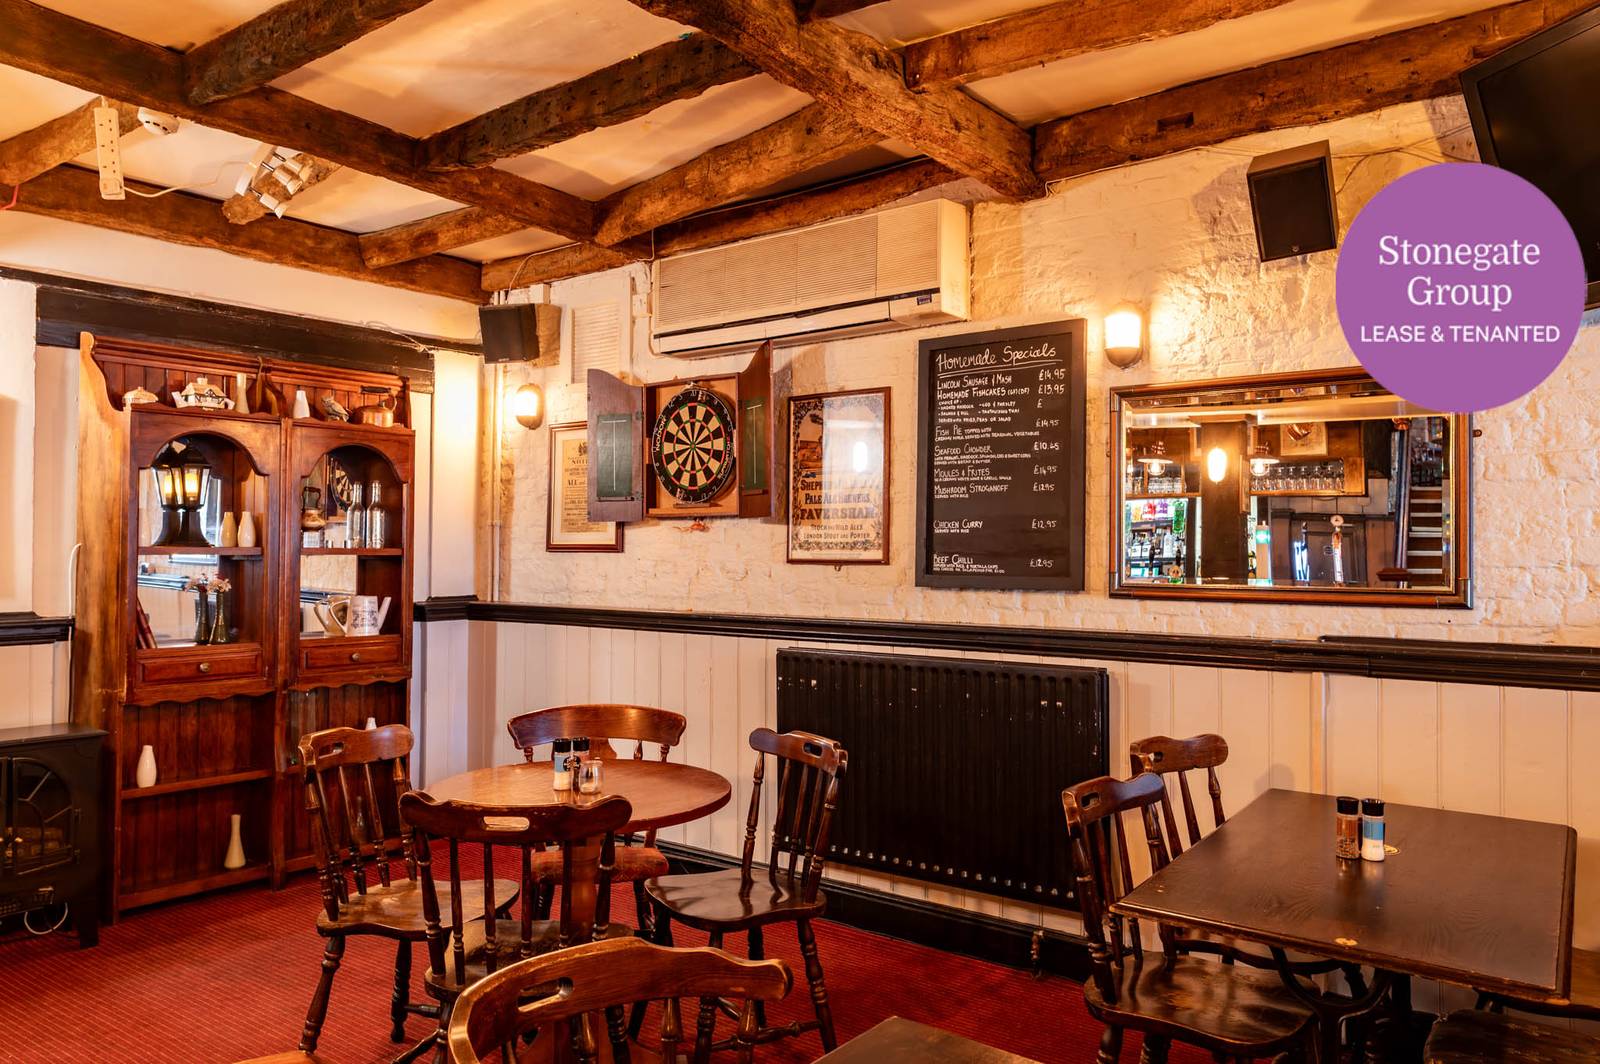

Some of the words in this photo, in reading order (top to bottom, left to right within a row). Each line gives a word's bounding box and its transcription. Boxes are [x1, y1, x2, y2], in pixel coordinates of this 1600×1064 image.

[935, 348, 997, 371] Homemade
[1002, 343, 1056, 366] Specials
[937, 380, 960, 390] LINCOLN
[996, 374, 1012, 385] MASH
[1039, 369, 1066, 381] £14.95
[937, 391, 969, 400] HOMEMADE
[972, 387, 1006, 398] FISHCAKES
[1038, 384, 1065, 395] £13.95
[934, 445, 961, 457] SEAFOOD
[964, 443, 992, 454] CHOWDER
[934, 468, 960, 478] MOULES
[968, 465, 990, 476] FRITES
[934, 484, 967, 494] MUSHROOM
[970, 482, 1009, 494] STROGANOFF
[805, 493, 822, 504] PALE
[962, 518, 983, 529] CURRY
[1031, 518, 1057, 530] £12.95
